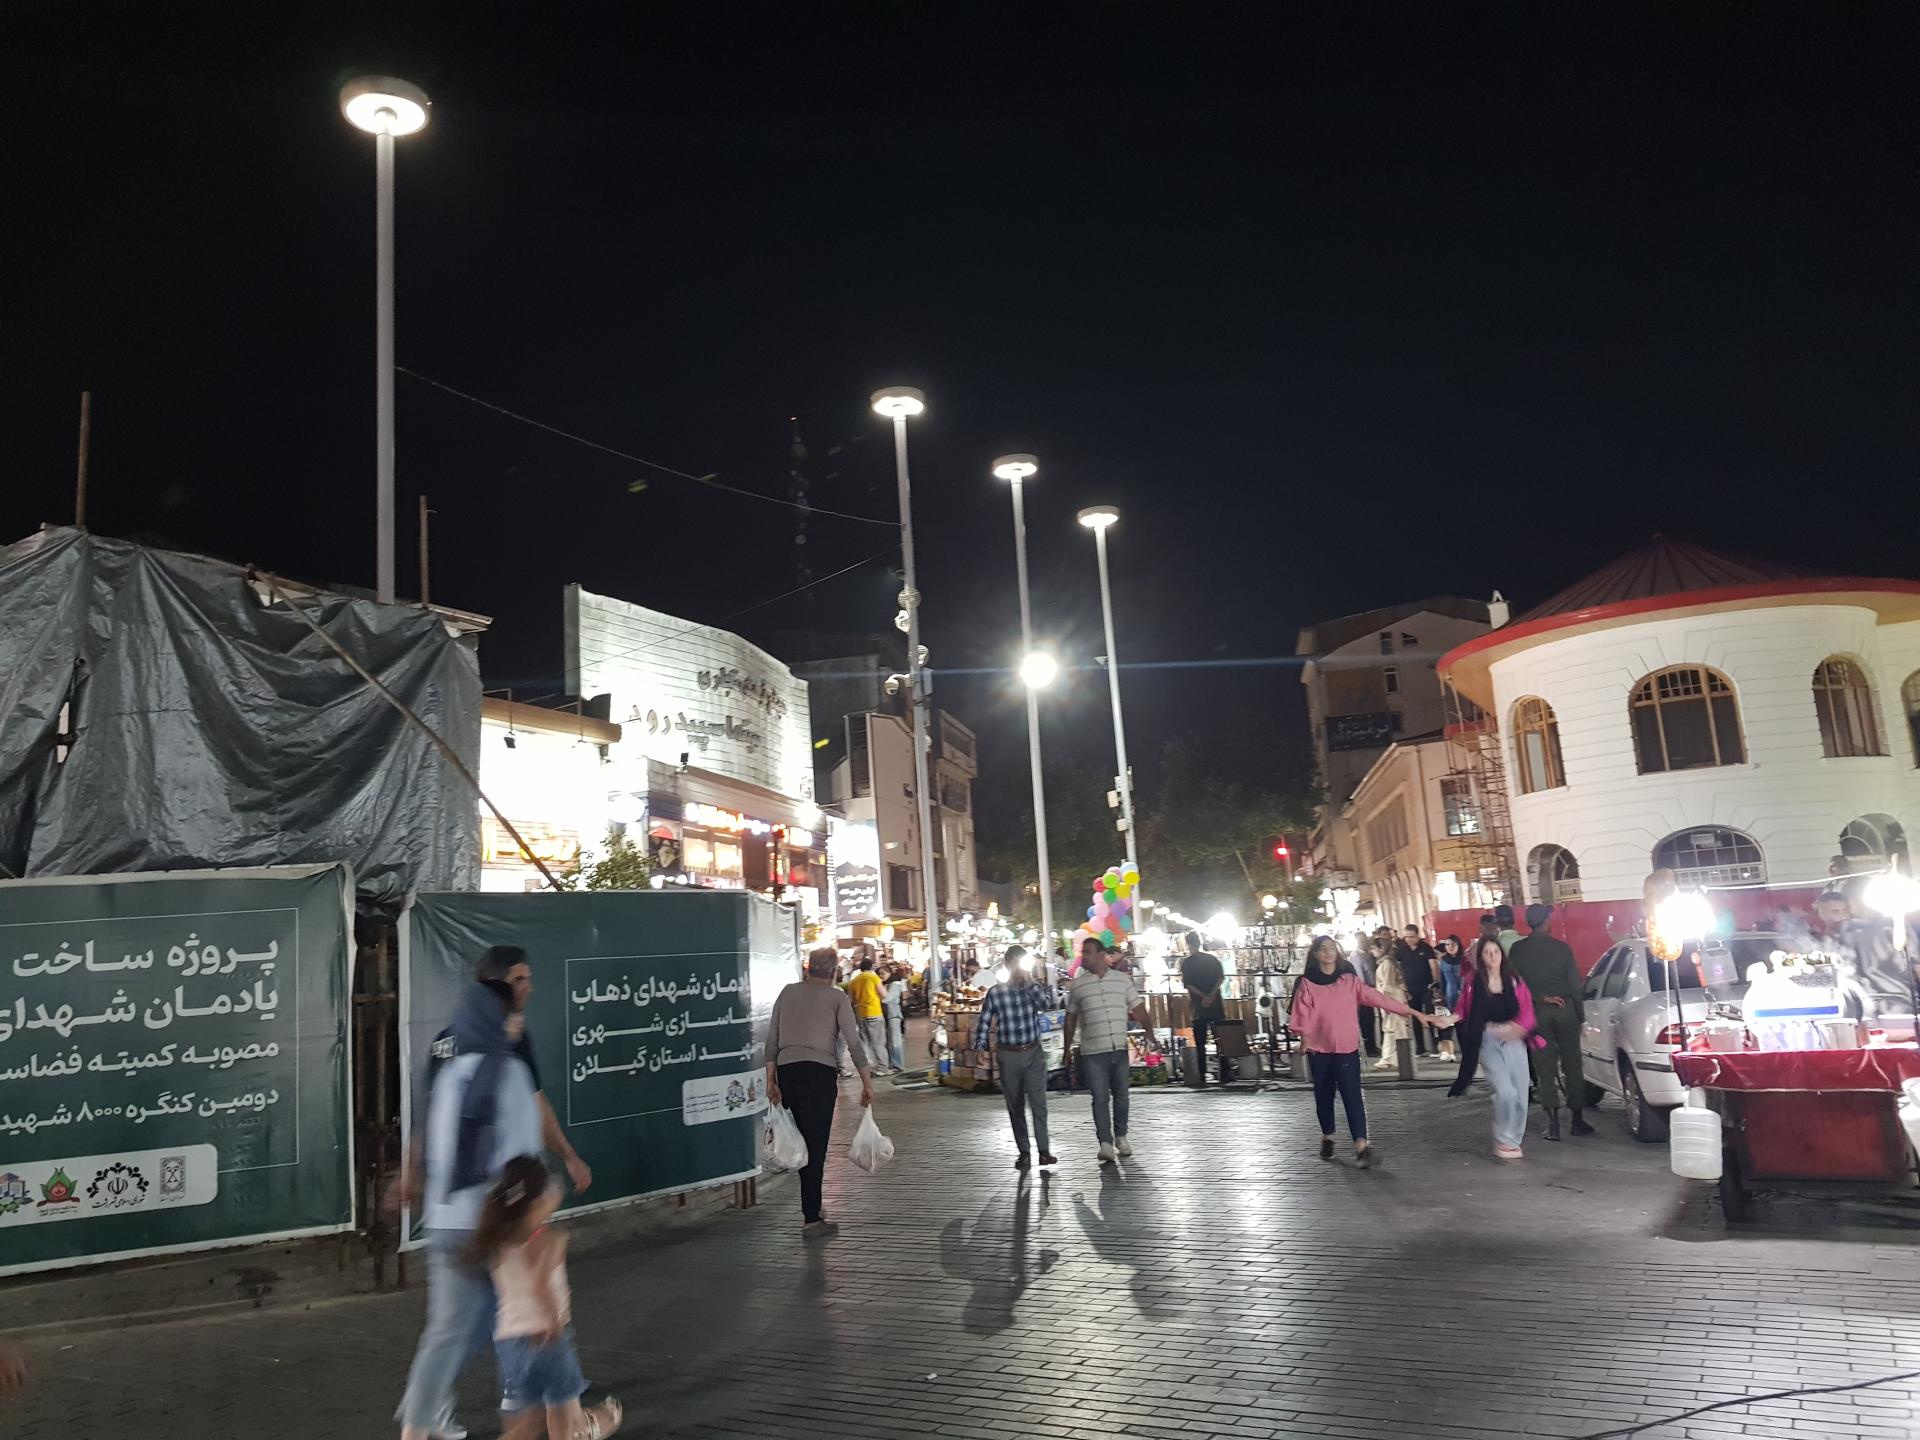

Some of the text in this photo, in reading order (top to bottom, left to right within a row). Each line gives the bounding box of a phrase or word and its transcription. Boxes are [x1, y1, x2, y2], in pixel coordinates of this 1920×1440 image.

[12, 932, 279, 978] پروژه ساخت
[143, 979, 279, 1030] یادمان
[571, 971, 750, 1011] ادمان شهدای ذهاب
[572, 1012, 664, 1046] شهری
[87, 1043, 178, 1077] کمیته
[180, 1041, 280, 1070] مصوبه
[573, 1045, 648, 1082] گیلان
[649, 1042, 697, 1073] استان
[125, 1090, 196, 1124] کنگره
[198, 1088, 280, 1117] دومین
